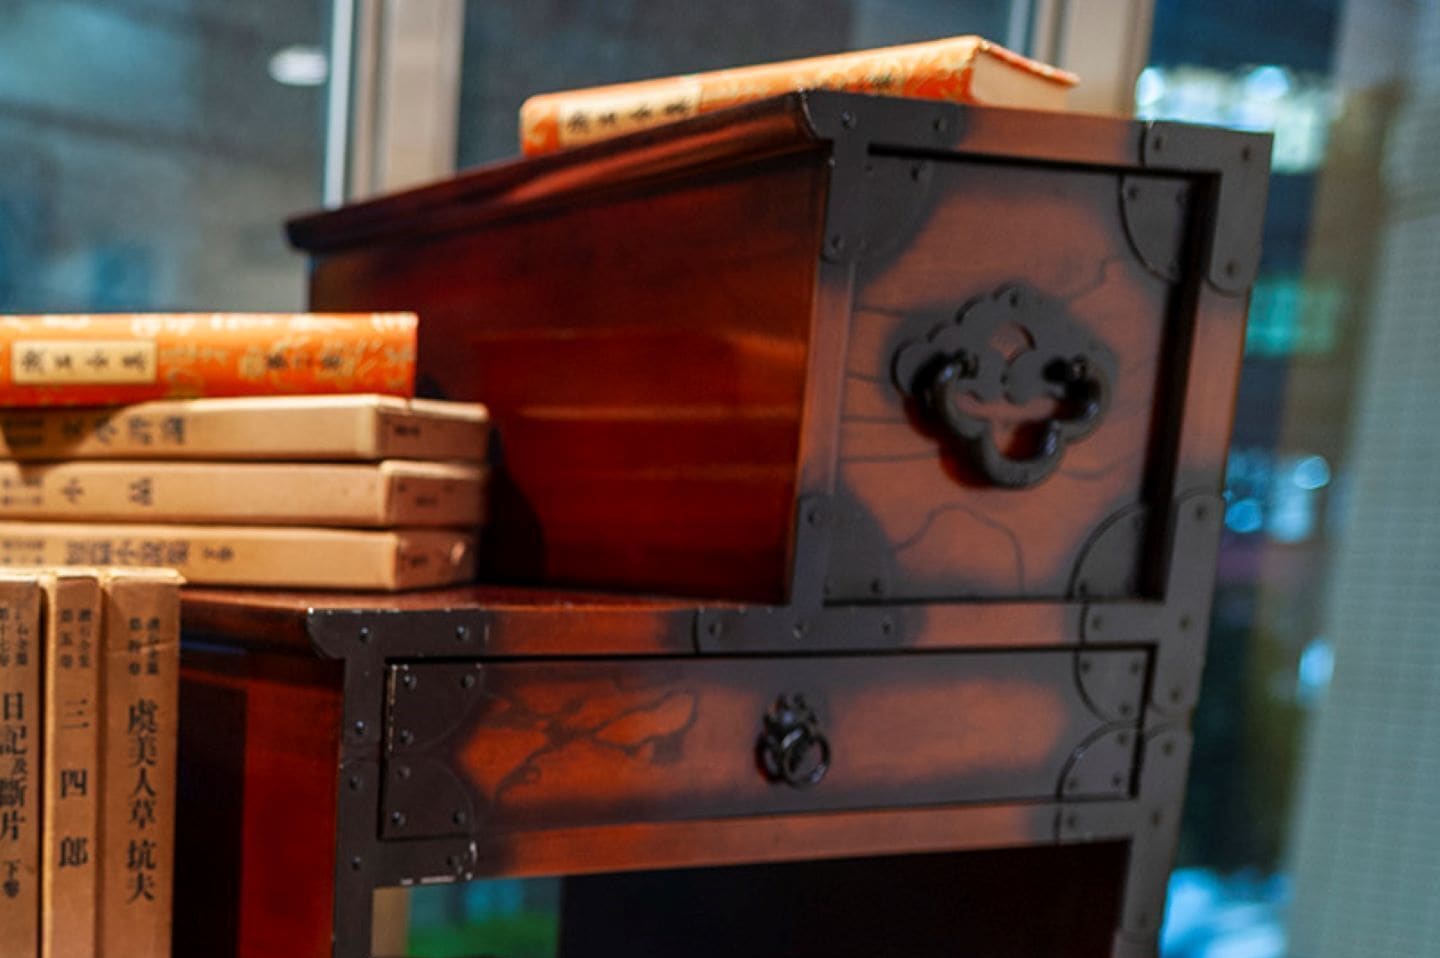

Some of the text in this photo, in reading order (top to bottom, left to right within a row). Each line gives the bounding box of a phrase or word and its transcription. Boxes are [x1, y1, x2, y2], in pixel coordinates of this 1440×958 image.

[58, 697, 90, 868] 三四郎
[125, 698, 159, 904] 虞美人草 坑夫
